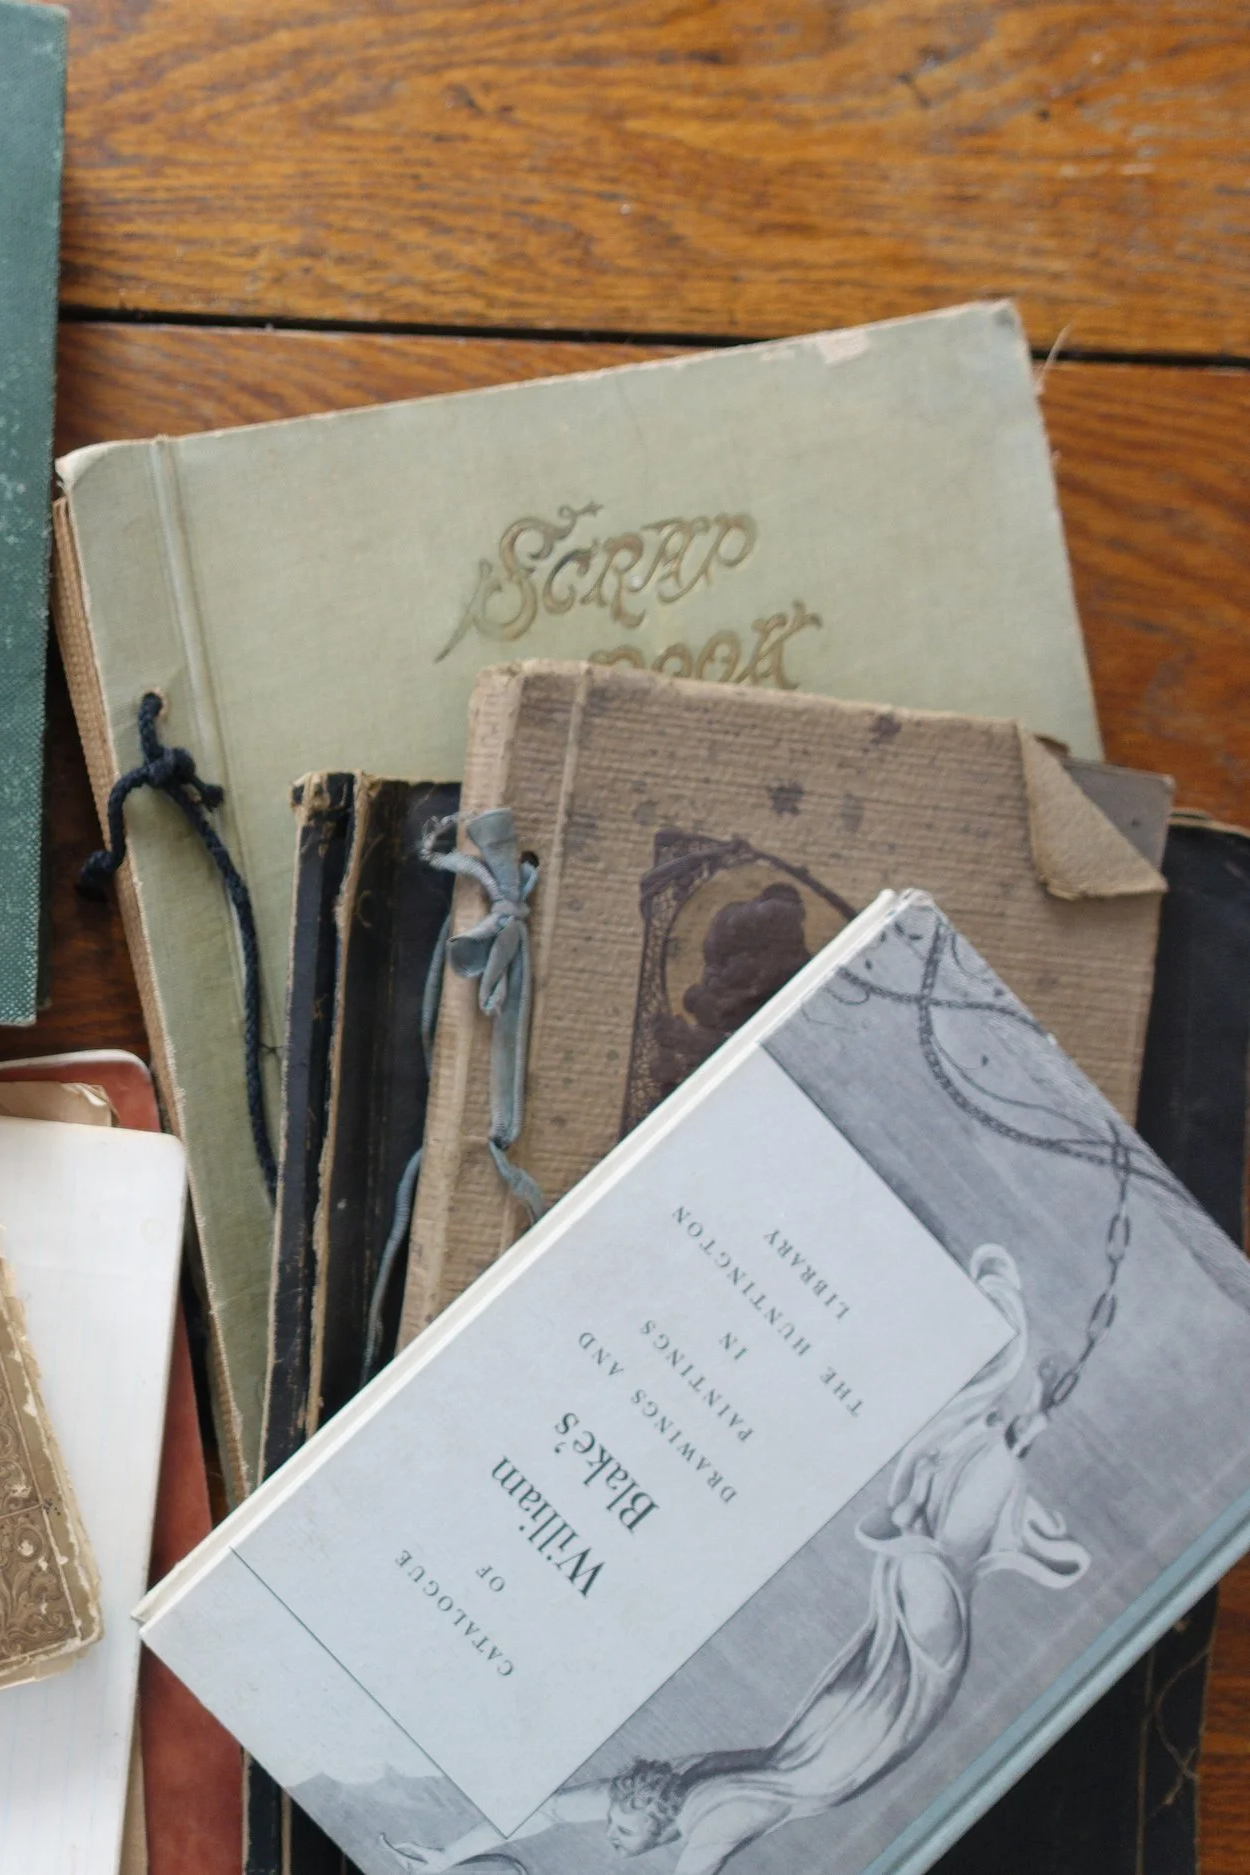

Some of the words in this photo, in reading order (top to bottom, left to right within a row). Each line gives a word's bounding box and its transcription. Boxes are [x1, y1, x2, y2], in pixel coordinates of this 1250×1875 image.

[671, 1204, 812, 1358] HUNTINGTON
[762, 1229, 851, 1323] LIBRARY
[577, 1330, 625, 1378] AND
[639, 1317, 755, 1443] PAINTINGS
[717, 1330, 749, 1361] IN
[818, 1365, 864, 1418] THE
[553, 1410, 660, 1534] Blake's
[630, 1387, 738, 1505] DRAWINGS
[474, 1564, 507, 1594] OF
[488, 1456, 606, 1600] William
[393, 1548, 516, 1679] CATALOGUE
